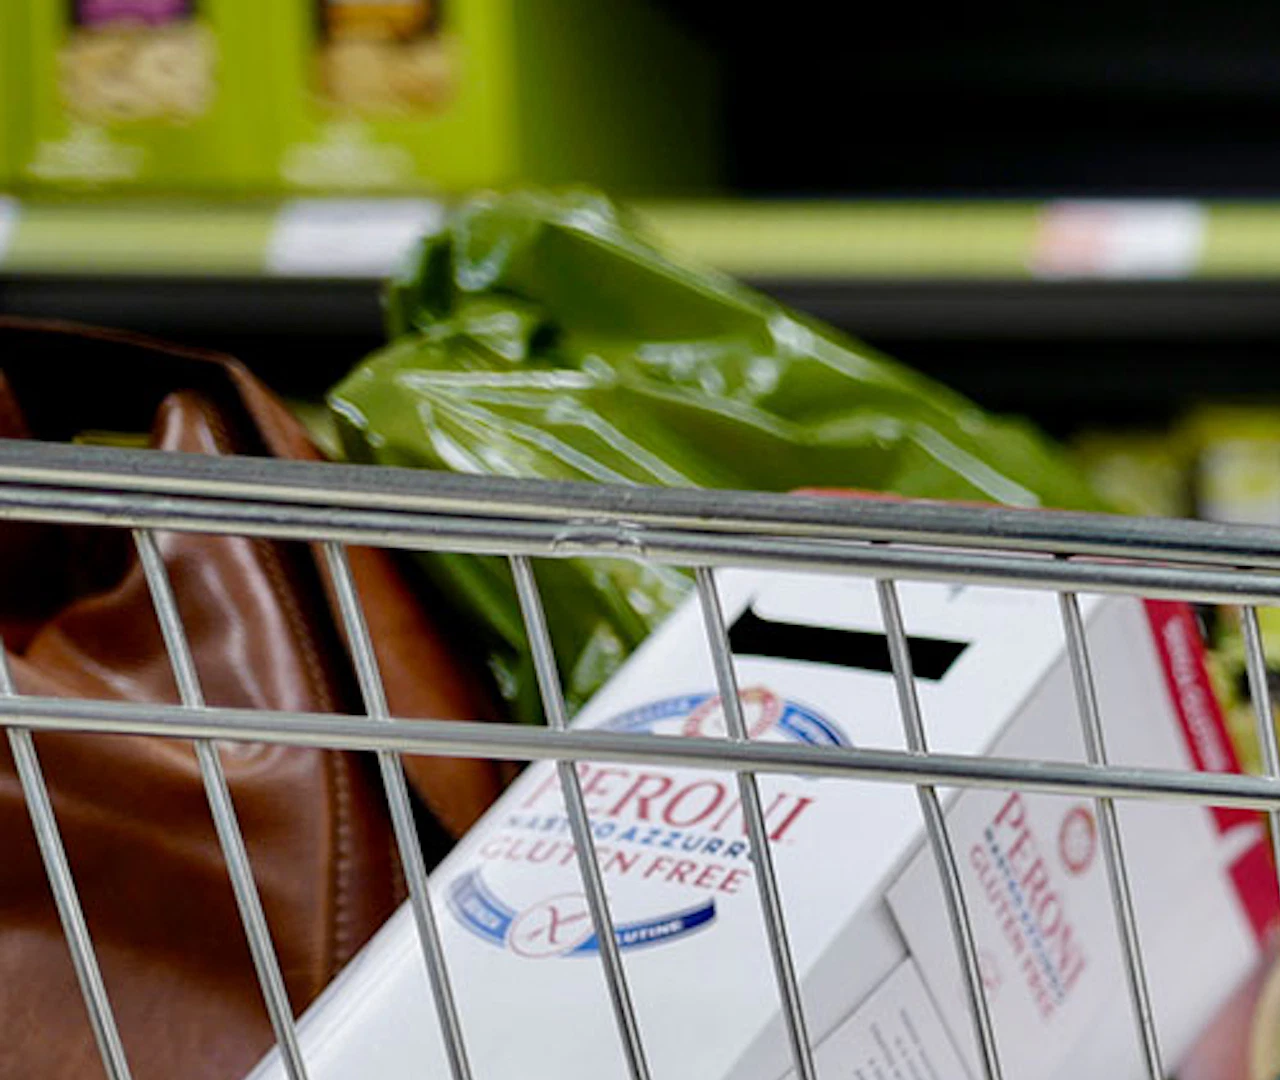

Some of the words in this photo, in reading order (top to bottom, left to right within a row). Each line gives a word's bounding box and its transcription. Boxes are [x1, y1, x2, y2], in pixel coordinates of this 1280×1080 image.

[523, 762, 816, 841] PERONI
[508, 814, 617, 841] NASTO
[617, 825, 753, 862] AZZURR
[642, 854, 751, 894] FREE
[993, 790, 1087, 993] PERONI
[613, 920, 682, 945] LUTINE
